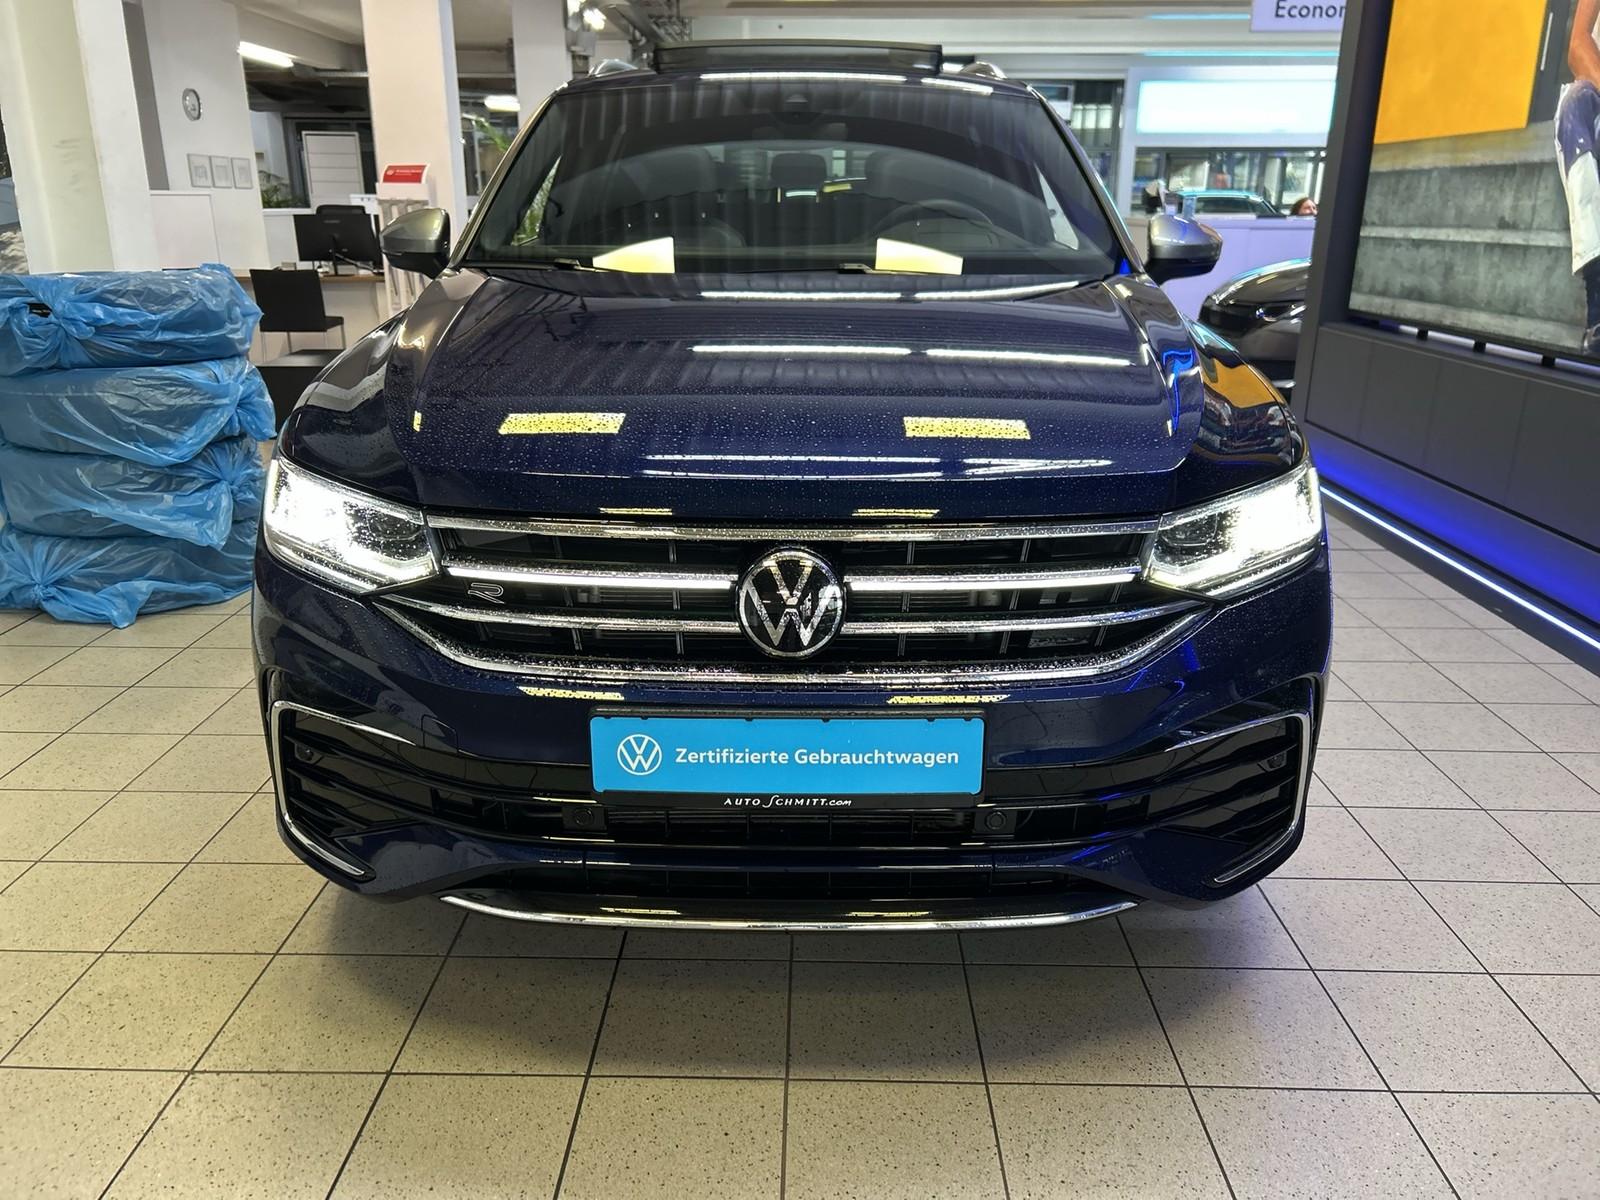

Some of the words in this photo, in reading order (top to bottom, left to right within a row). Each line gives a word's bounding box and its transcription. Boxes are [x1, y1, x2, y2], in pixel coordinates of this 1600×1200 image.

[616, 733, 663, 776] VW
[675, 748, 789, 764] Zertifizierte
[794, 749, 959, 767] Gebrauchtwagen
[723, 797, 761, 806] AUTO
[762, 794, 852, 808] SCHMITT.com
